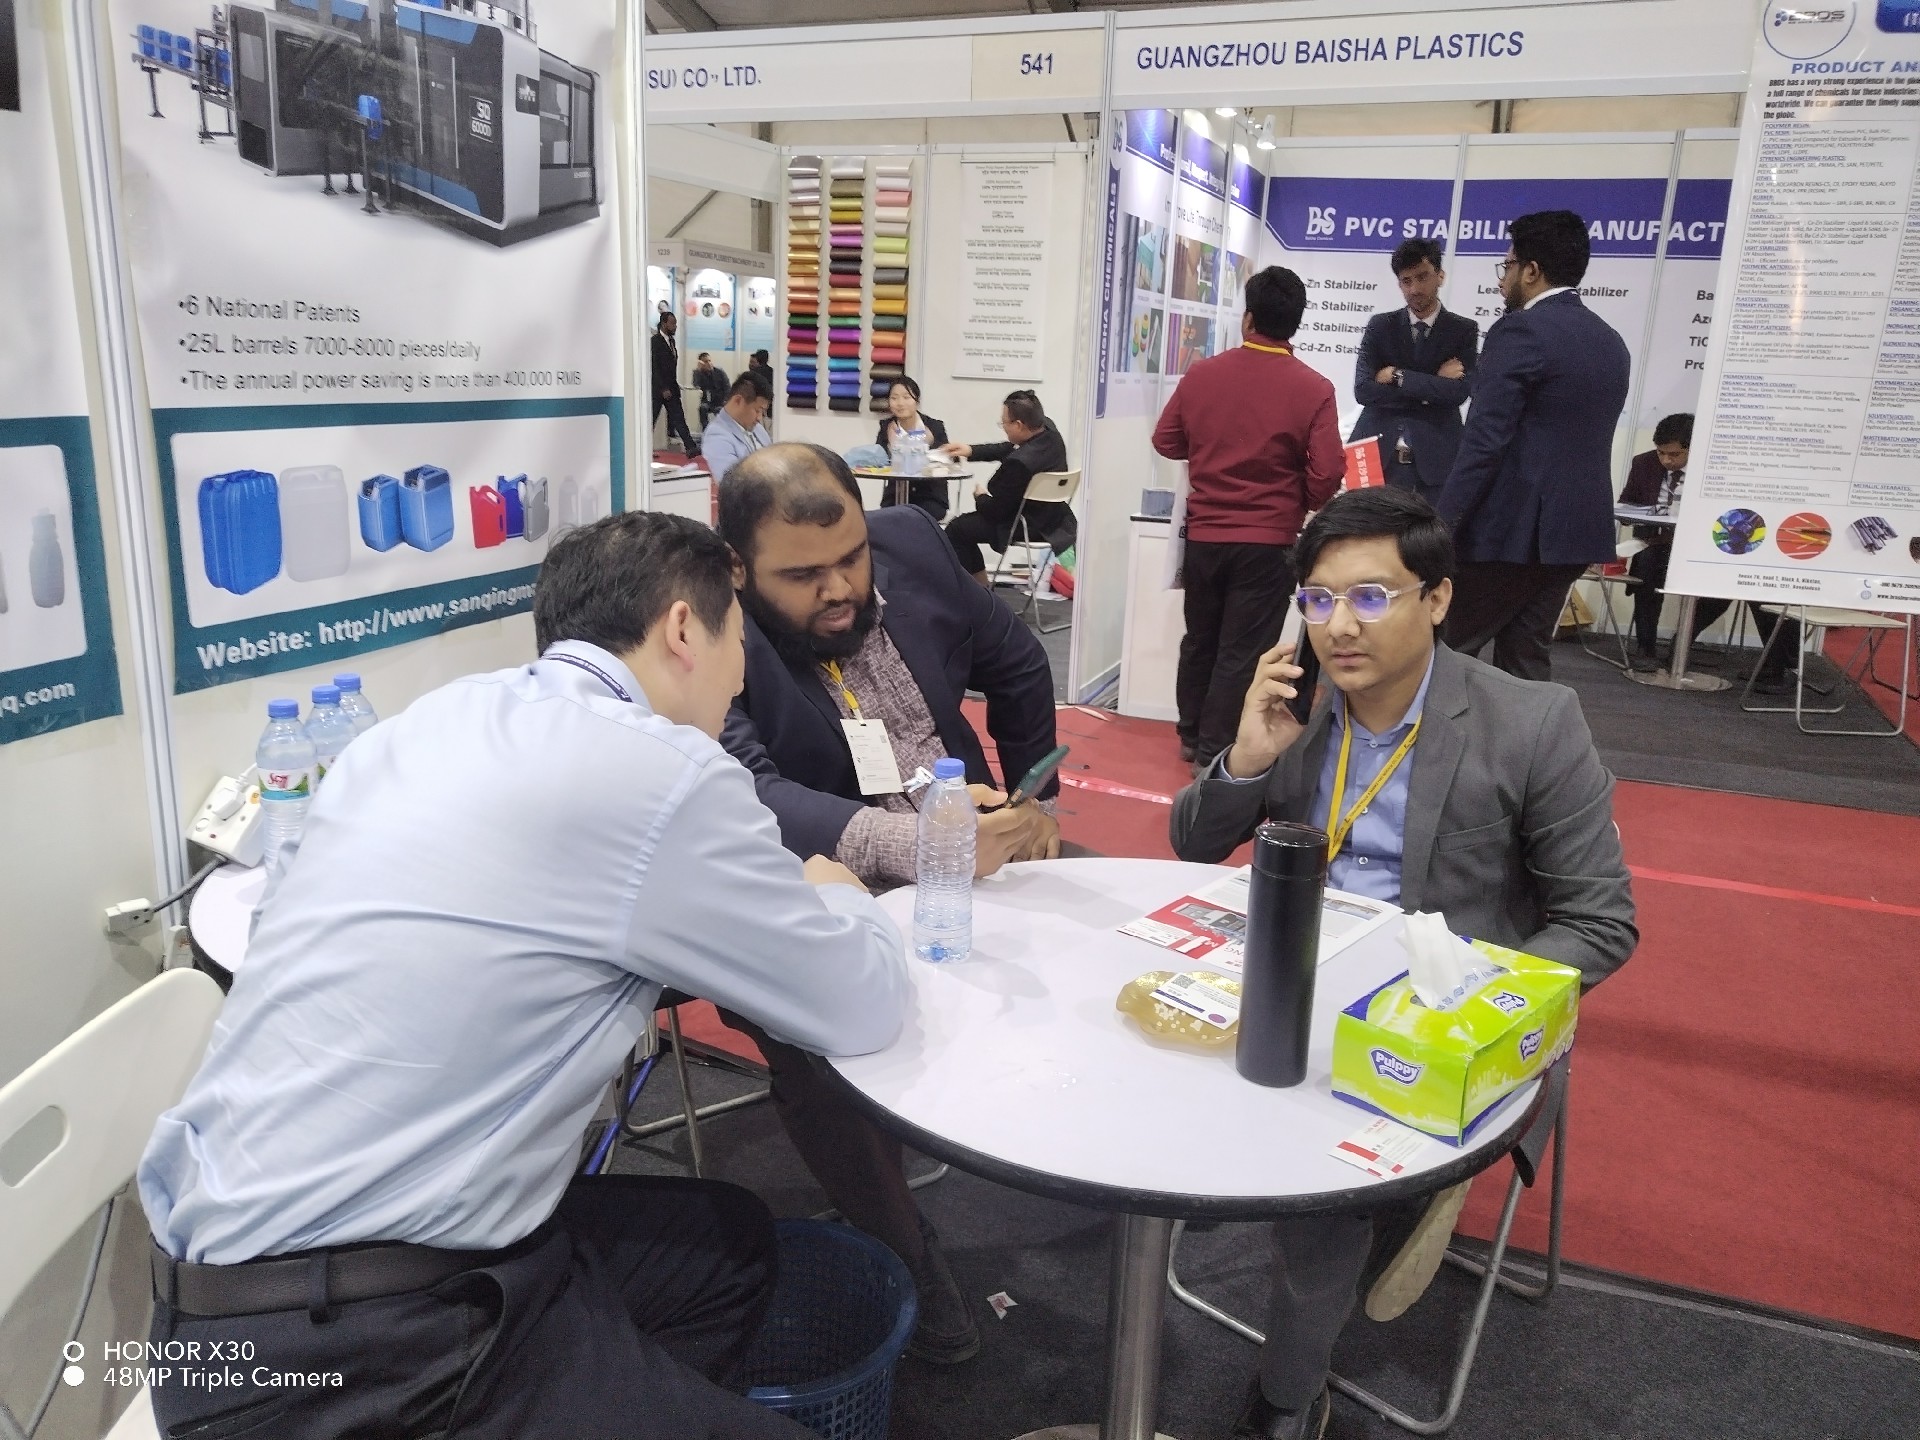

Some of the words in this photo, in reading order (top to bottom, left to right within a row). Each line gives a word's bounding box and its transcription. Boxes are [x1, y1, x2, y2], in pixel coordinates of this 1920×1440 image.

[1136, 41, 1287, 70] GUANGZHOU
[1295, 37, 1388, 64] BAISHA
[1395, 30, 1524, 61] PLASTICS
[1020, 52, 1054, 76] 541
[1791, 61, 1885, 75] PRODUCT
[645, 69, 677, 89] SU)
[724, 66, 762, 86] LTD.
[1807, 79, 1821, 87] very
[1823, 78, 1845, 86] strong
[1847, 78, 1884, 86] experience
[1894, 77, 1906, 85] the
[1765, 100, 1802, 109] worldwide.
[1804, 100, 1814, 108] We
[1829, 99, 1864, 108] guarantee
[1866, 98, 1877, 106] the
[1878, 98, 1899, 108] timely
[1785, 90, 1805, 98] range
[1815, 88, 1850, 97] chemicals
[1863, 88, 1882, 96] these
[1883, 87, 1917, 95] industries
[1764, 111, 1775, 119] the
[1776, 111, 1797, 120] globe.
[1344, 216, 1394, 239] PVC
[1402, 217, 1514, 241] STABILI
[1588, 219, 1726, 242] ANUFACT
[1105, 182, 1118, 302] CHEMICALS
[1304, 278, 1321, 289] -Zn
[1477, 284, 1502, 295] Lea
[1577, 286, 1629, 298] tabilizer
[1321, 300, 1375, 312] Stabilizer
[1696, 290, 1715, 301] Ba
[186, 295, 199, 316] 6
[205, 295, 289, 321] National
[294, 300, 361, 323] Patents
[1475, 306, 1490, 317] Zn
[1494, 306, 1502, 317] S
[186, 333, 226, 354] 25L
[231, 333, 299, 355] barrels
[303, 336, 395, 358] 7000-8000
[399, 338, 481, 362] pieces/daily
[1098, 308, 1109, 384] BAISHA
[1292, 342, 1332, 353] -Cd-Zn
[1335, 344, 1361, 354] Stab
[187, 370, 228, 391] The
[233, 370, 298, 390] annual
[302, 373, 357, 394] power
[360, 370, 414, 393] saving
[418, 371, 431, 388] is
[434, 373, 470, 388] more
[472, 371, 502, 388] than
[503, 370, 553, 388] 400,000
[195, 629, 313, 671] Website:
[0, 682, 76, 719] q.com
[1375, 1051, 1420, 1082] Pulppy
